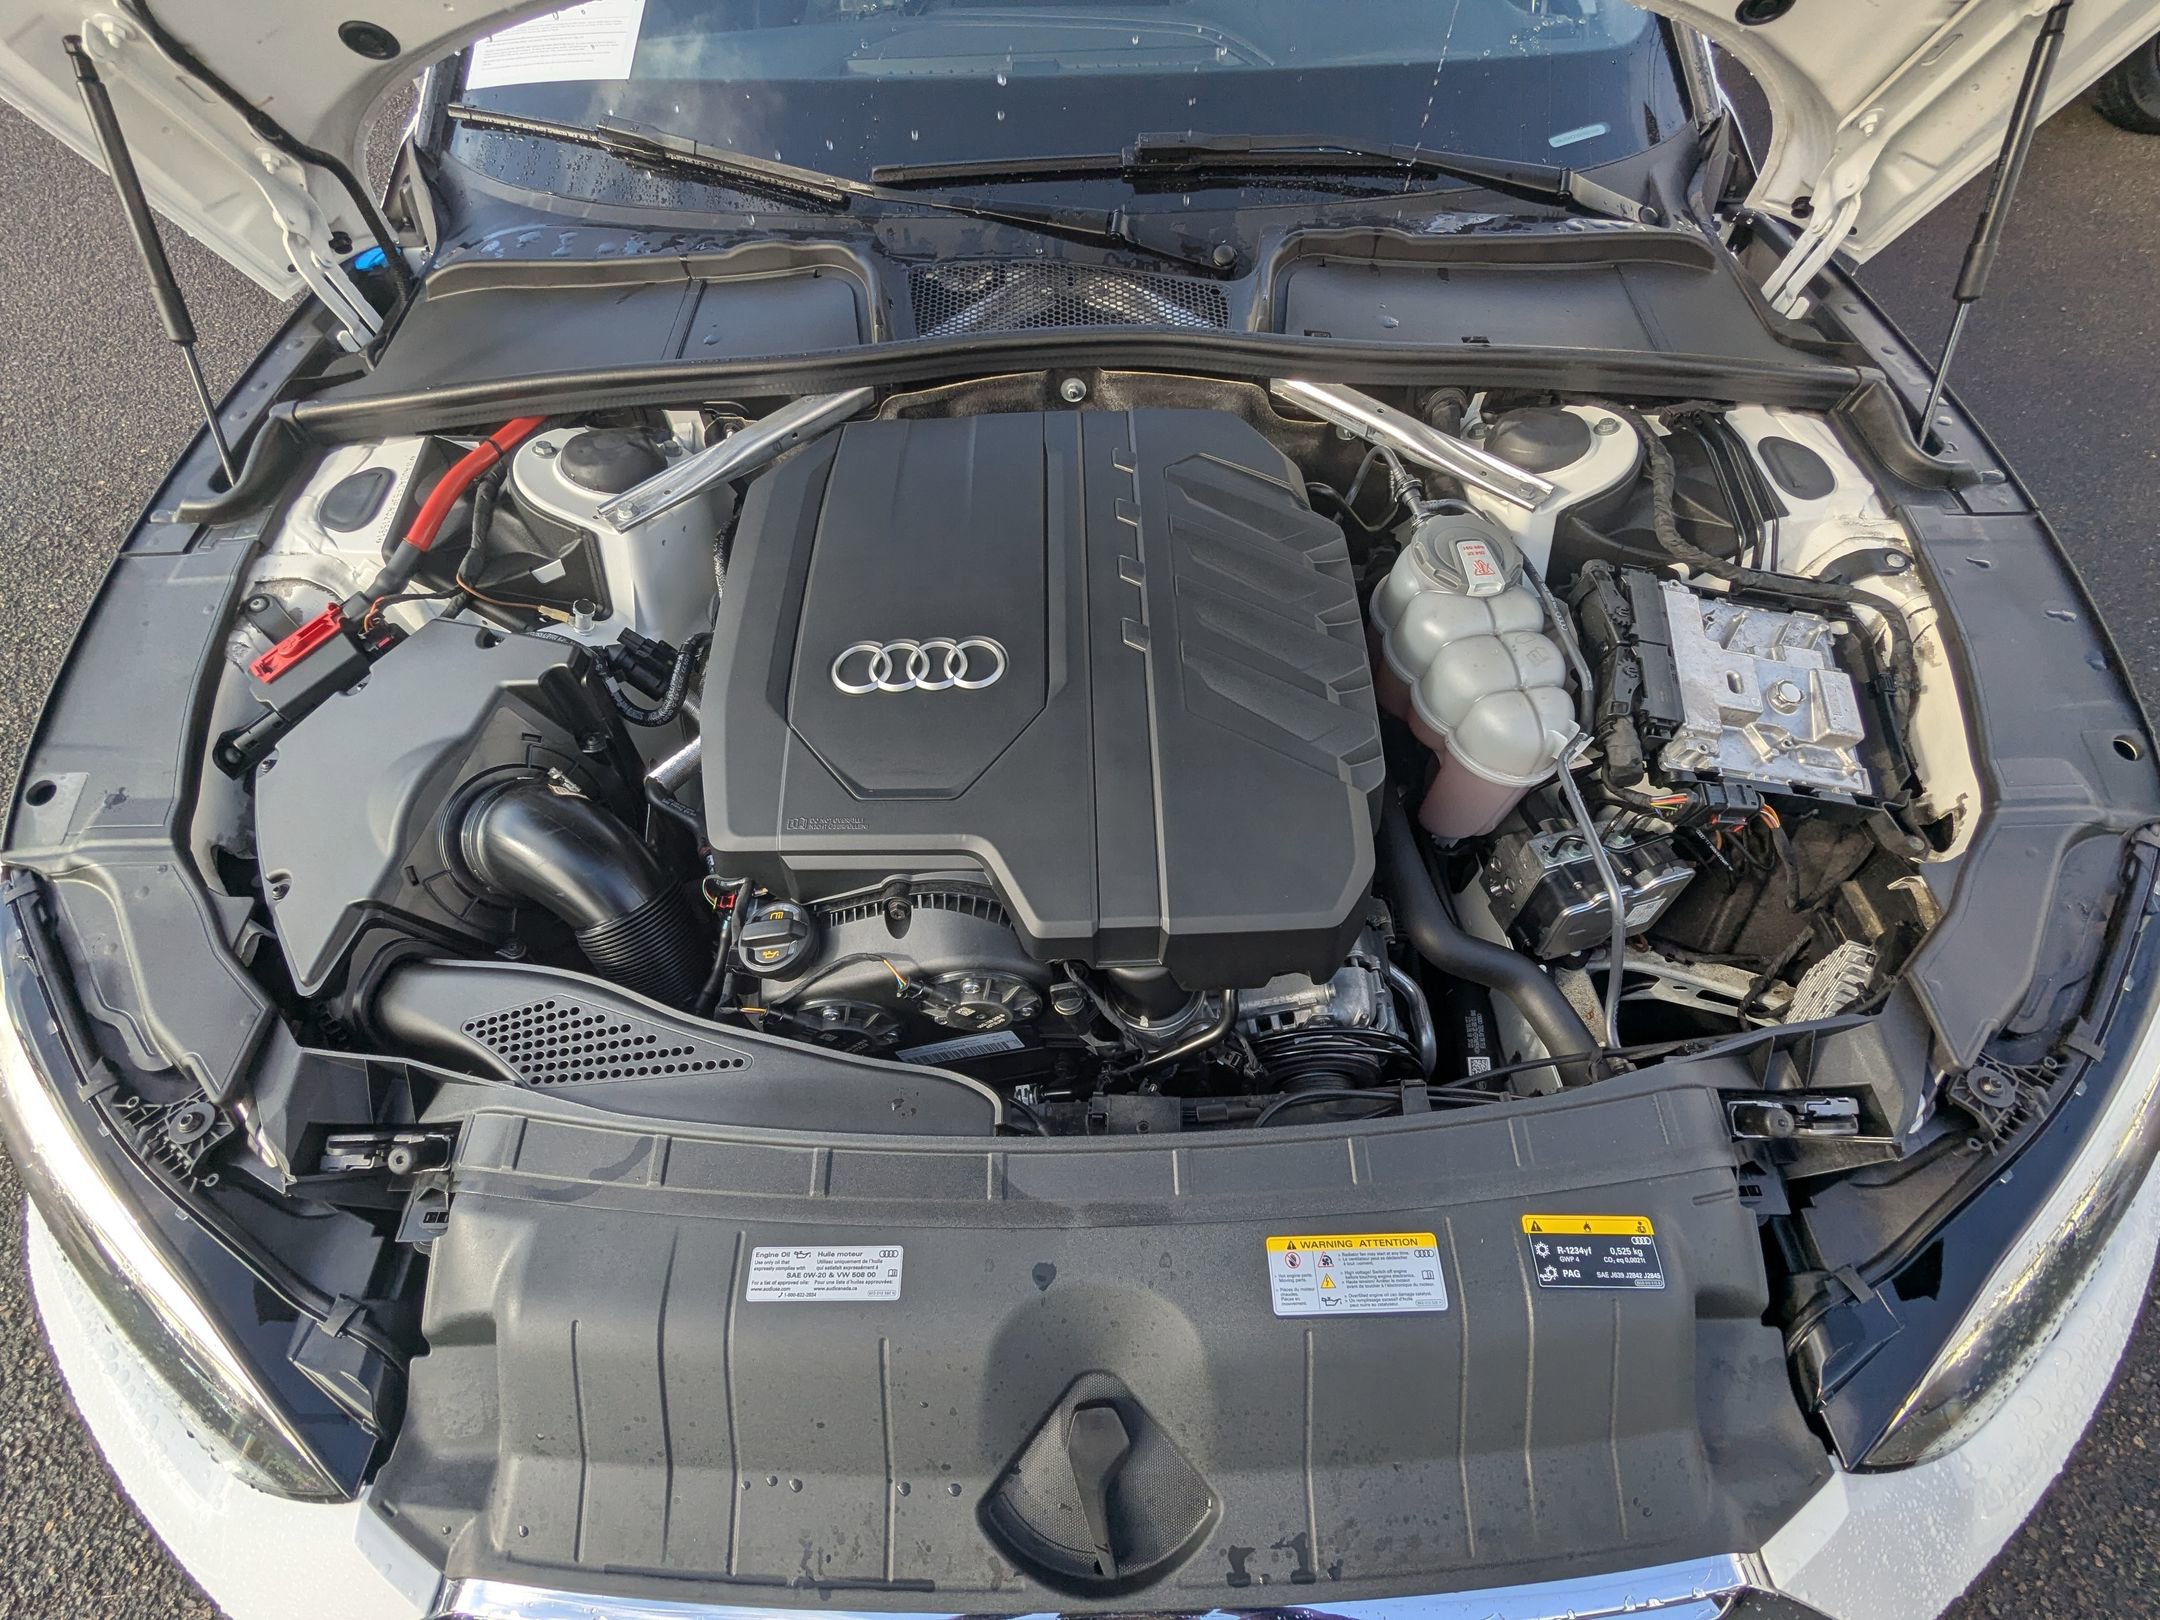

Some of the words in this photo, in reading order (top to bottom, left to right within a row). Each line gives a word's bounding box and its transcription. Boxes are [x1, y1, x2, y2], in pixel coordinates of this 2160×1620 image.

[1300, 1239, 1353, 1249] WARNING
[1359, 1238, 1418, 1247] ATTENTION
[1557, 1246, 1592, 1256] R-1234yf
[1609, 1247, 1631, 1255] 0,525
[1633, 1247, 1643, 1257] kg
[1563, 1269, 1581, 1278] PAG
